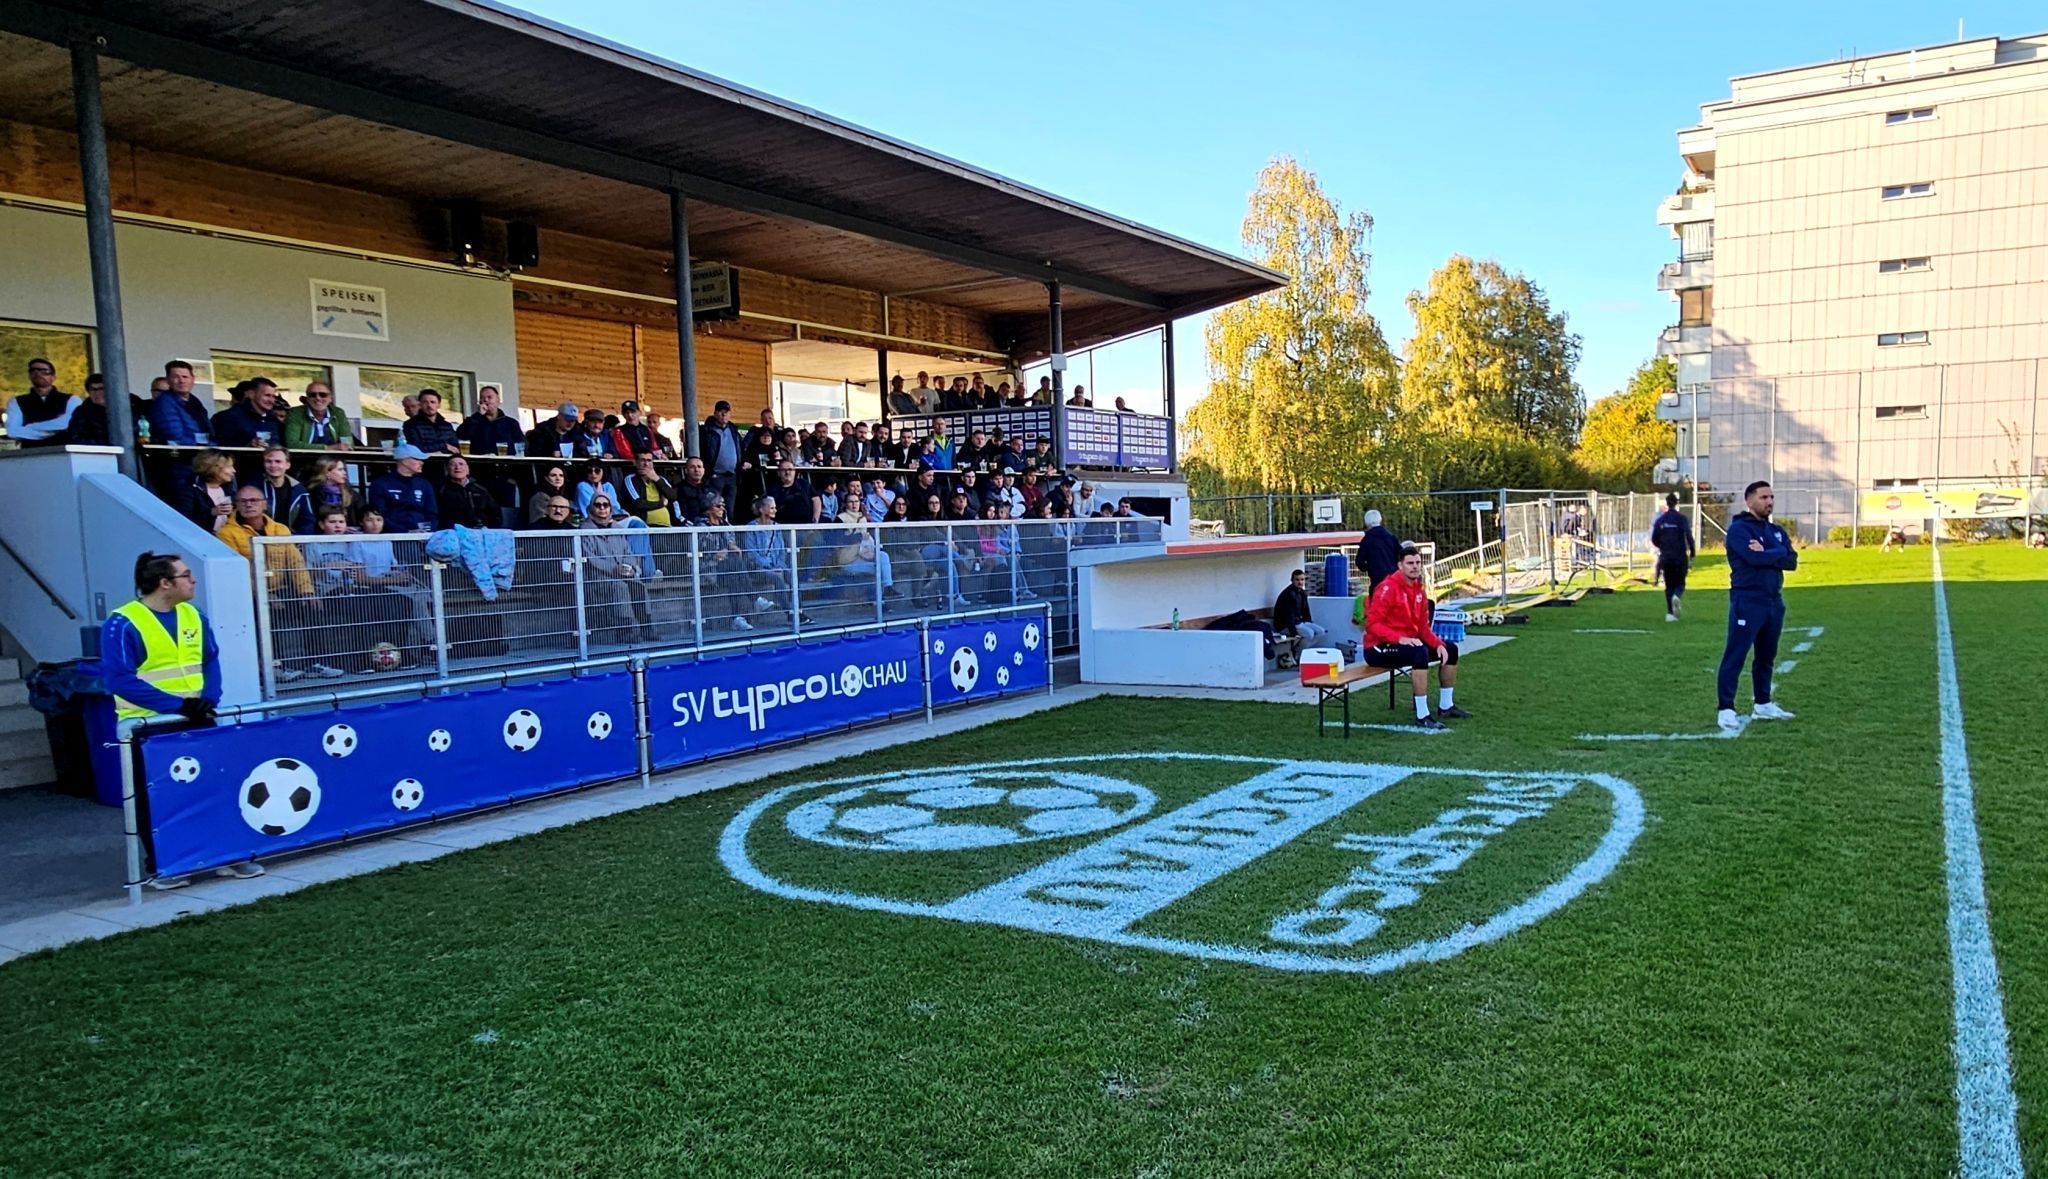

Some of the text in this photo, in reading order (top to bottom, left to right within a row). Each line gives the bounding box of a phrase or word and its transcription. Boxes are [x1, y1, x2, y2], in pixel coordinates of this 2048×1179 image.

[321, 287, 375, 303] SPEISEN
[672, 660, 907, 731] SV typico LOCHAU
[1024, 771, 1372, 910] LOCHAU
